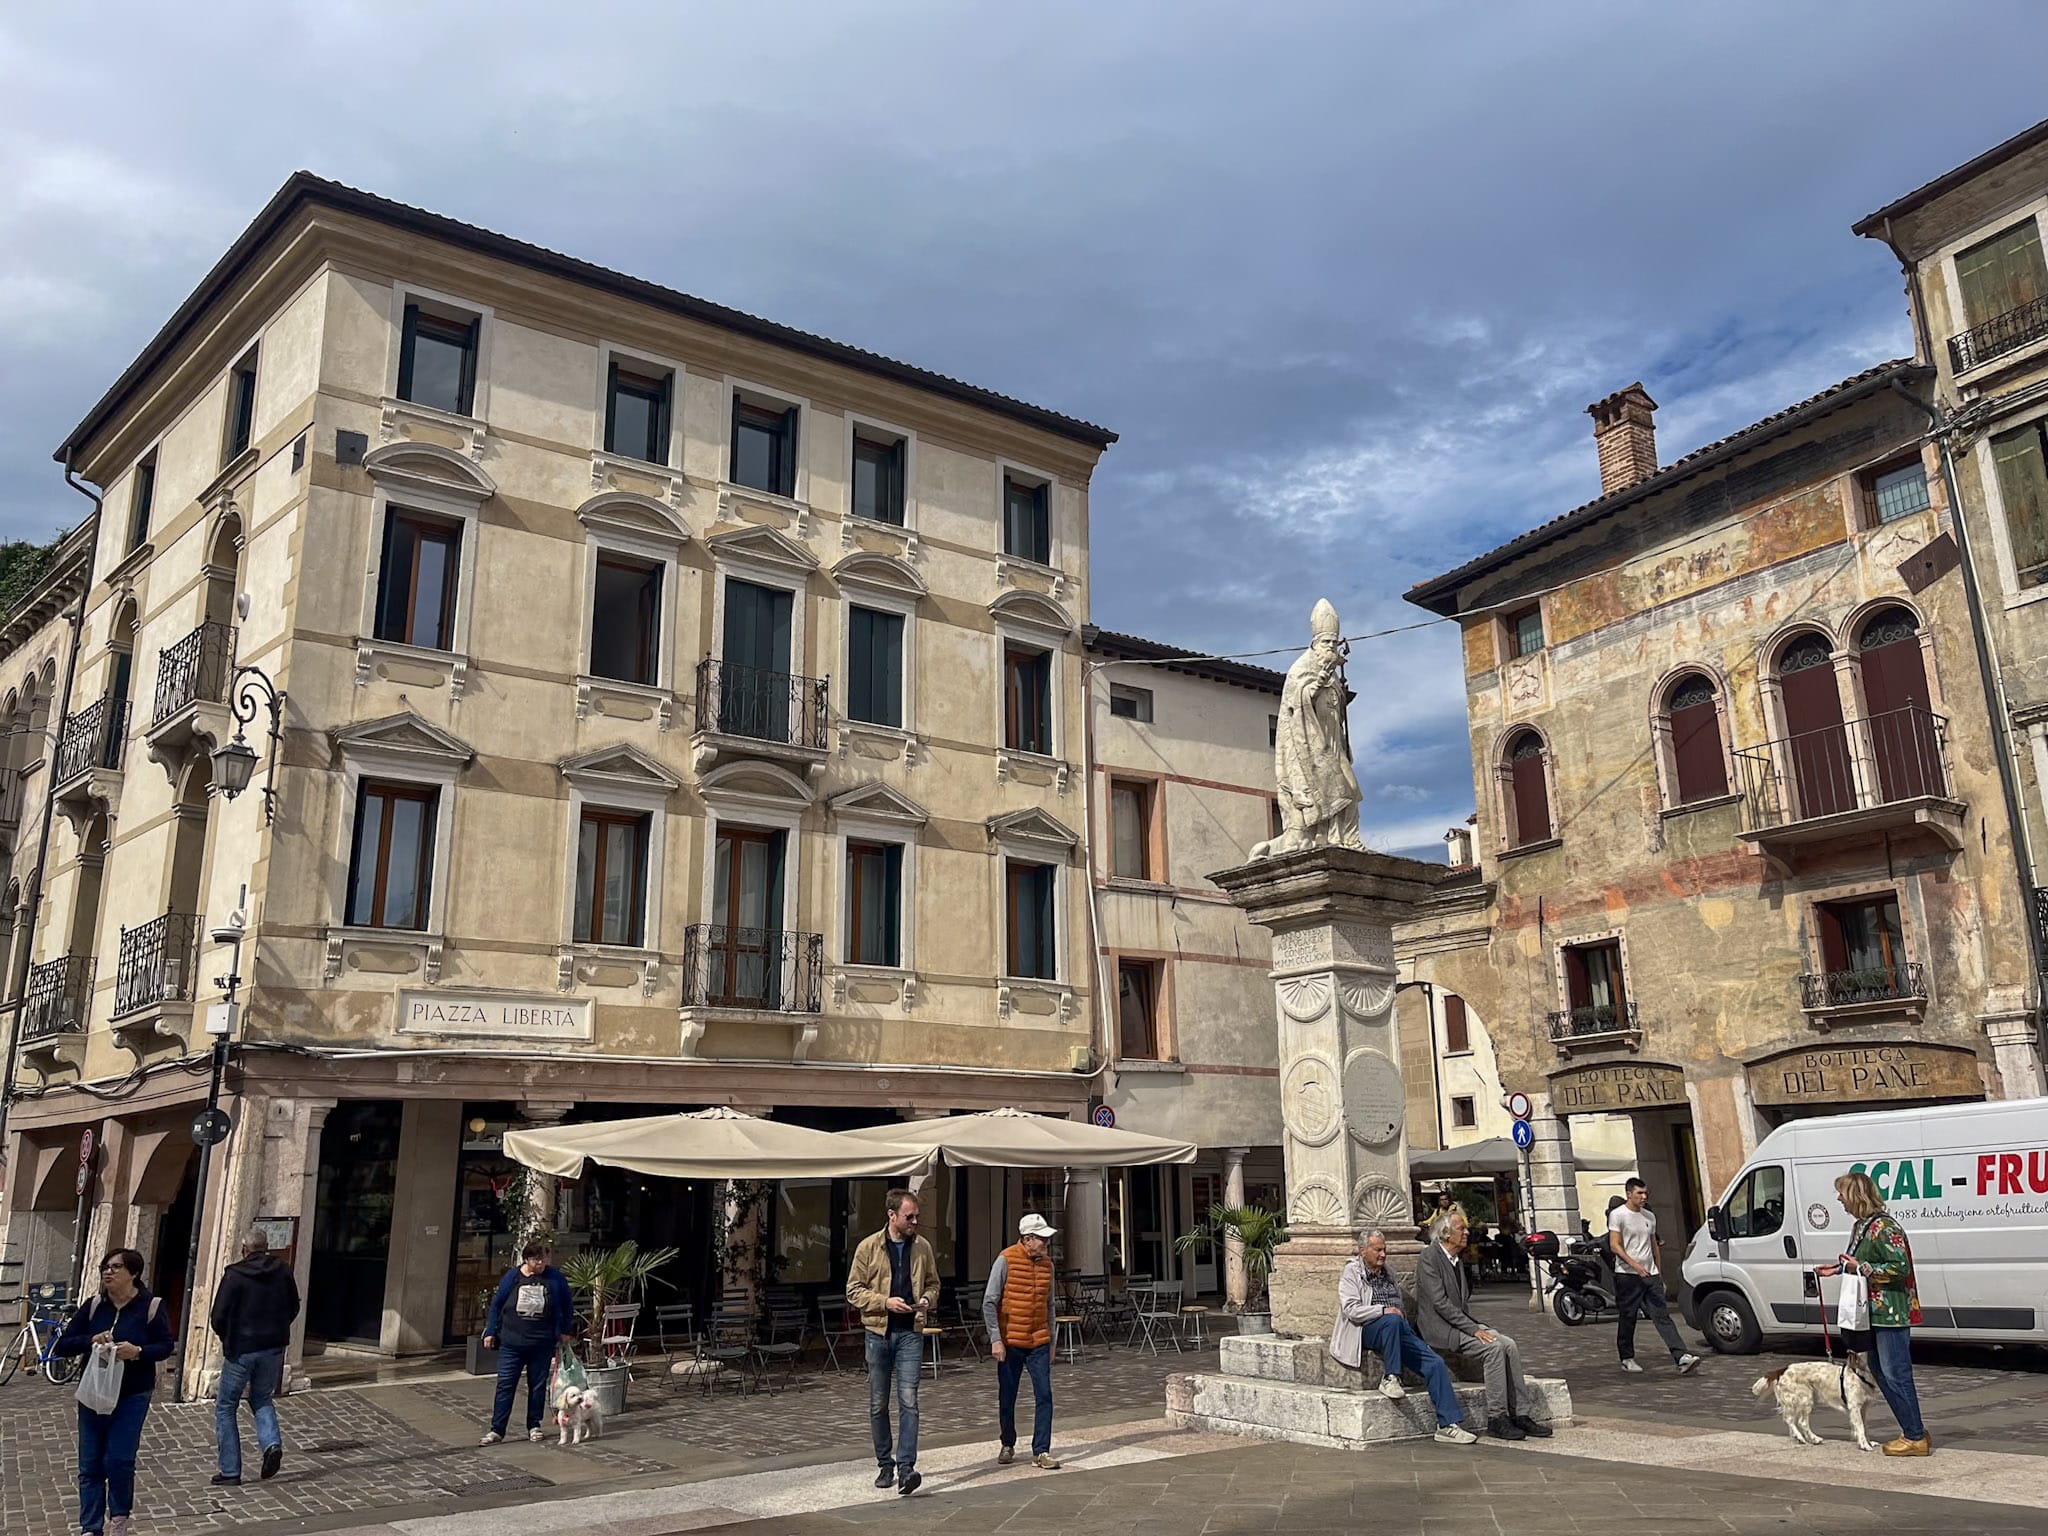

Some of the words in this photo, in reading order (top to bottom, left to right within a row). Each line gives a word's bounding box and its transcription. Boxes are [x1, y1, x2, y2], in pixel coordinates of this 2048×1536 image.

[413, 1003, 487, 1023] PIAZZA
[502, 1008, 575, 1026] LIBERTÀ
[1805, 1048, 1907, 1068] BOTTEGA
[1578, 1067, 1657, 1084] BOTTEGA
[1783, 1070, 1837, 1094] DEL
[1852, 1063, 1930, 1090] PANE
[1565, 1086, 1606, 1106] DEL
[1617, 1080, 1677, 1103] PANE
[1849, 1158, 1942, 1201] CAL
[1895, 1209, 1917, 1220] 1988
[1921, 1205, 1984, 1222] distribuzione
